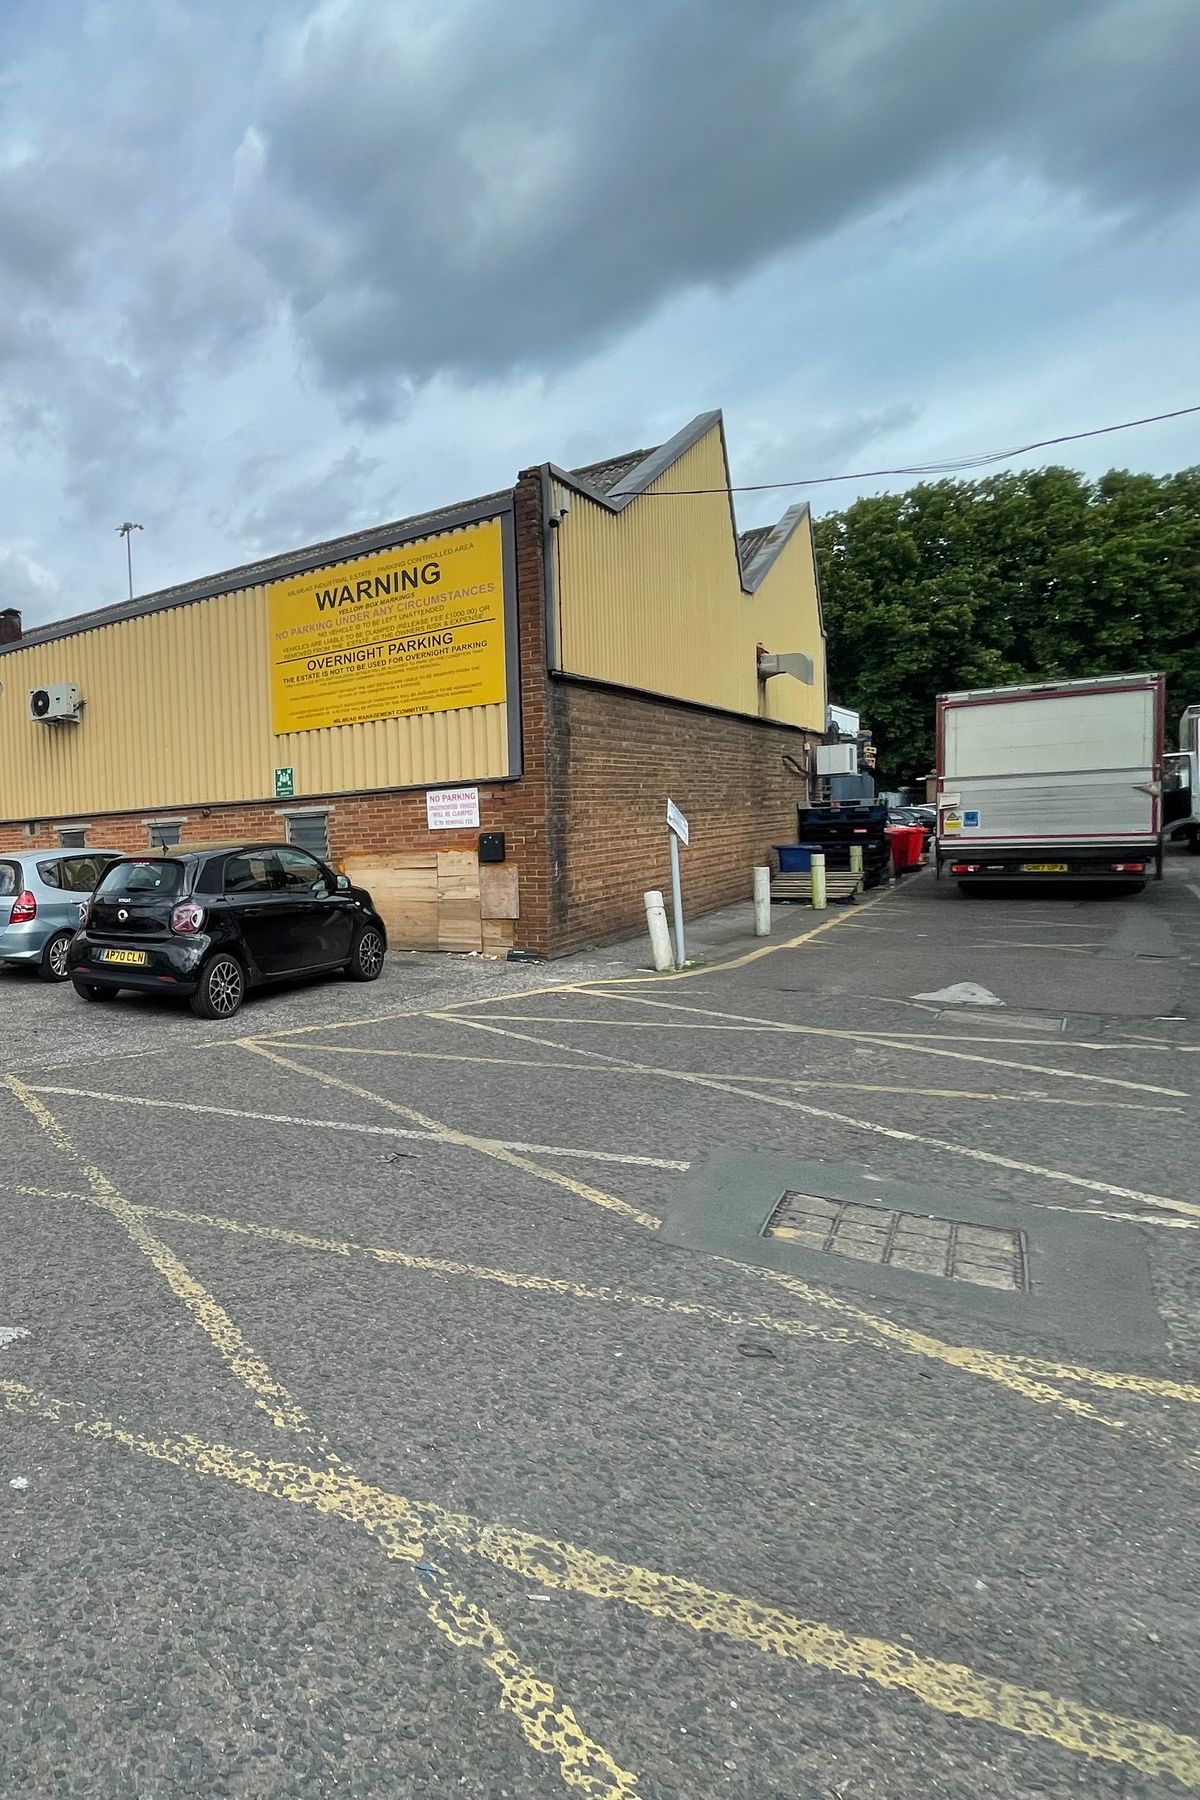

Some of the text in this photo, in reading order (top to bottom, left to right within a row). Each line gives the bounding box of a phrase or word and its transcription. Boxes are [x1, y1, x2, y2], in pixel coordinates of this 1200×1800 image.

[314, 576, 348, 590] INDUSTRIAL
[350, 570, 372, 580] ESTATE
[377, 561, 406, 573] PARKING
[407, 548, 453, 565] CONTROLLED
[454, 543, 474, 553] AREA
[315, 562, 440, 611] WARNING
[339, 604, 364, 615] YELLOW
[380, 592, 415, 605] MARKINGS
[275, 583, 495, 640] NO PARKING UNDER ANY CIRCUMSTANCES
[329, 626, 353, 635] VEHICLE
[382, 616, 397, 624] LEFT
[399, 605, 444, 619] UNATTENDED
[282, 643, 309, 654] VEHICLES
[323, 636, 344, 645] LIABLE
[365, 626, 395, 637] CLAMPED
[397, 619, 429, 630] (RELEASE
[283, 649, 312, 659] REMOVED
[313, 646, 330, 654] FROM
[347, 638, 369, 647] ESTATE
[381, 632, 393, 640] THE
[395, 626, 424, 637] OWNERS
[426, 622, 442, 630] RISK
[450, 614, 484, 625] EXPENSE
[307, 633, 453, 671] OVERNIGHT PARKING
[296, 673, 319, 682] ESTATE
[357, 663, 367, 671] BE
[368, 660, 386, 668] USED
[388, 656, 404, 664] FOR
[406, 647, 450, 661] OVERNIGHT
[452, 640, 487, 652] PARKING
[358, 710, 395, 721] MANAGEMENT
[396, 706, 429, 714] COMMITTEE
[442, 793, 476, 802] PARKING
[105, 950, 144, 962] AP70 CLN
